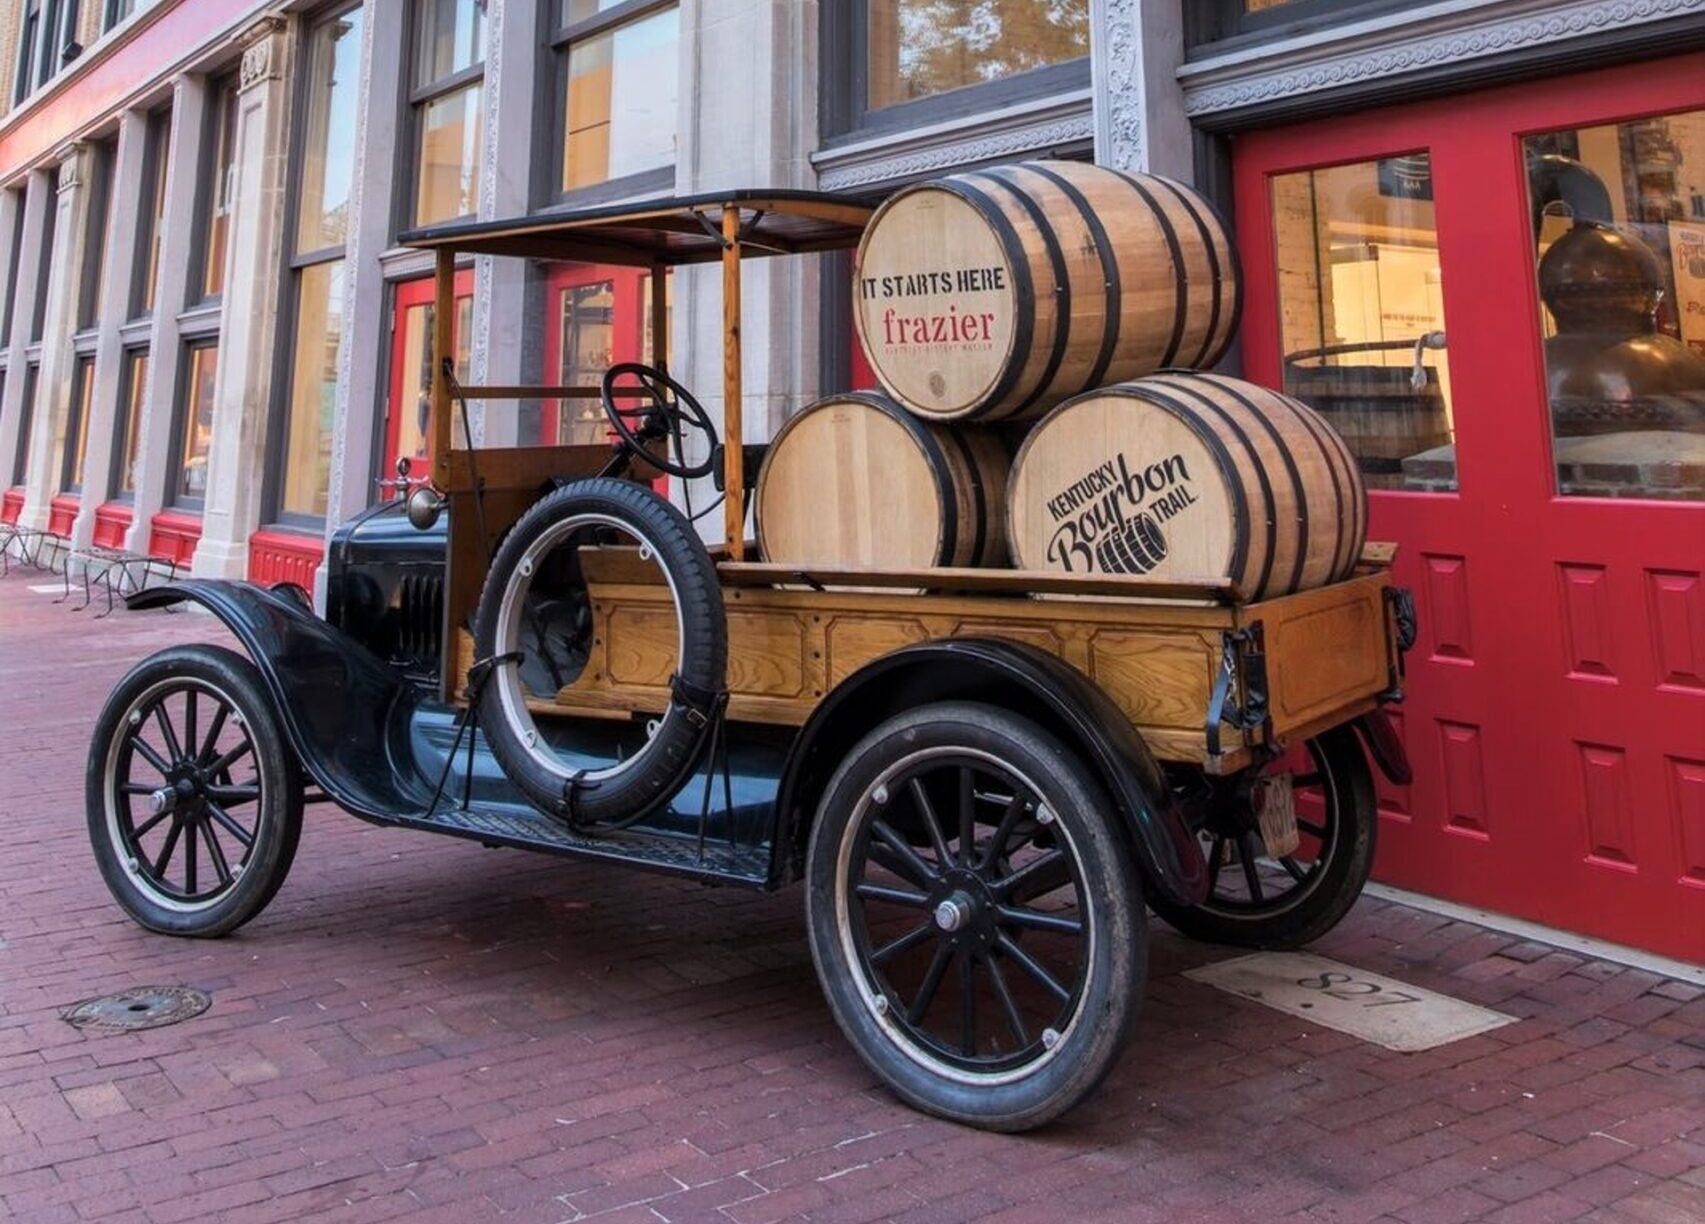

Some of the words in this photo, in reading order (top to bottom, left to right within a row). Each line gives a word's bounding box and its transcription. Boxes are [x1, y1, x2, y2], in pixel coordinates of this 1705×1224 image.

[862, 278, 877, 299] IT
[882, 271, 953, 298] STARTS
[957, 267, 1005, 292] HERE
[883, 304, 994, 344] frazier
[1047, 460, 1118, 521] KENTUCKY
[1149, 484, 1197, 523] TRAIL
[1047, 452, 1191, 573] Bourbon
[1296, 971, 1422, 1008] 827
